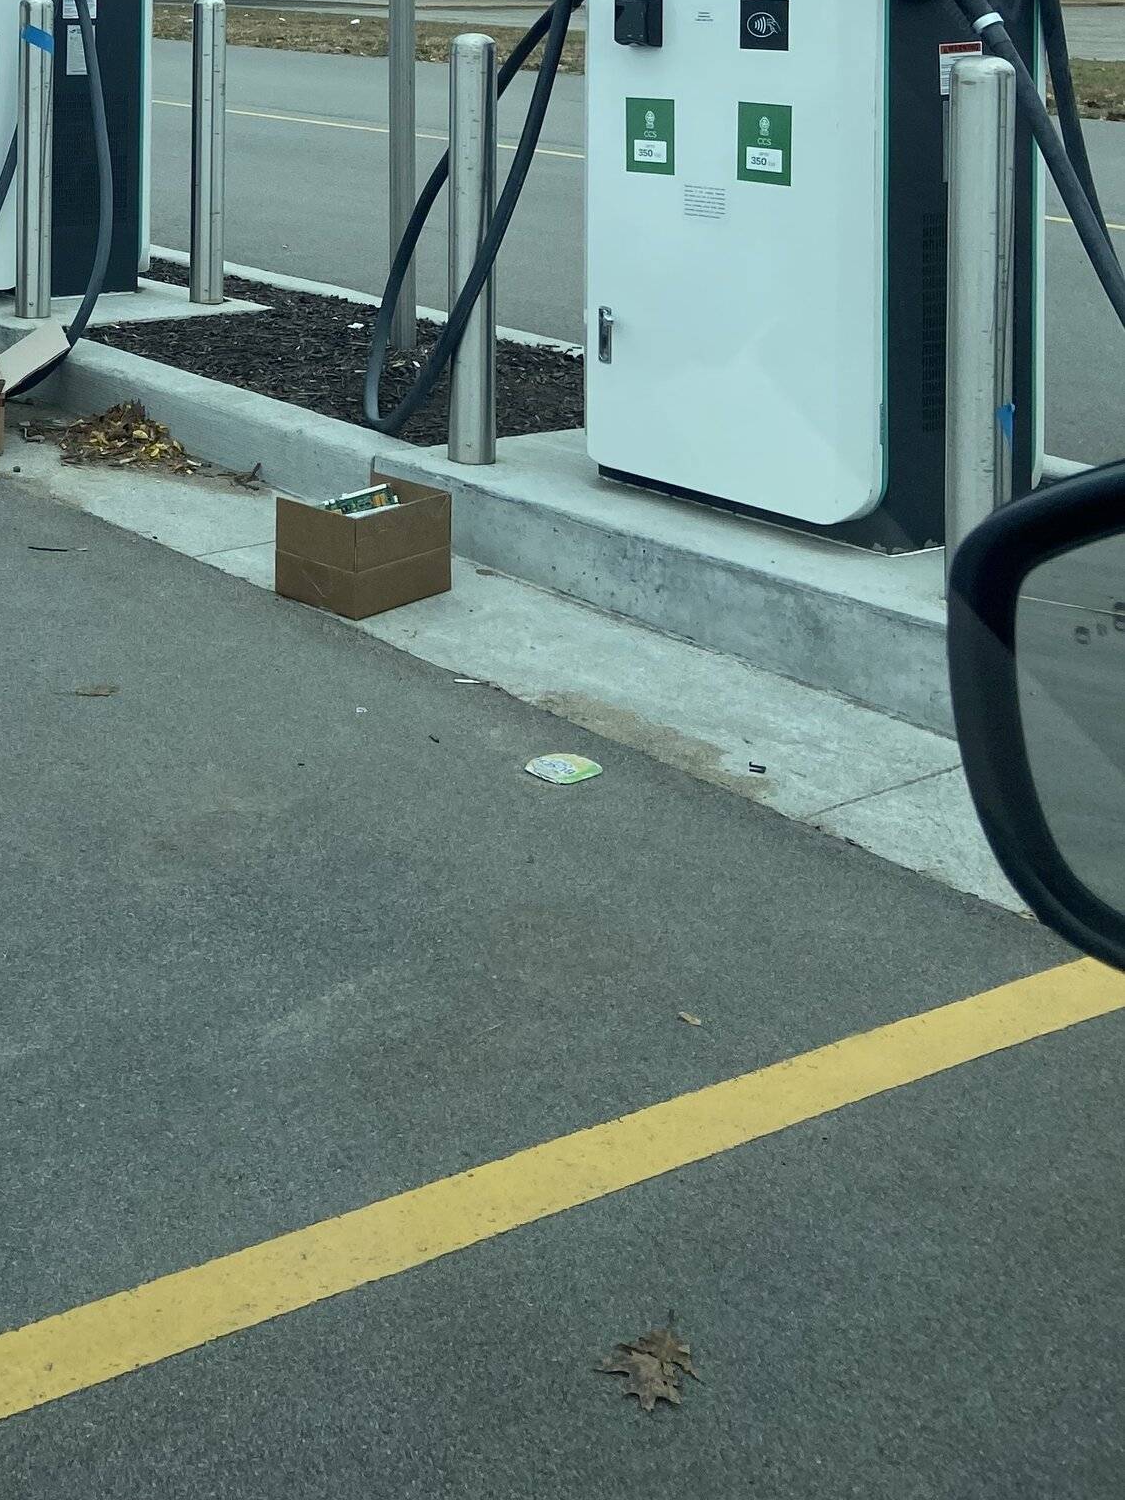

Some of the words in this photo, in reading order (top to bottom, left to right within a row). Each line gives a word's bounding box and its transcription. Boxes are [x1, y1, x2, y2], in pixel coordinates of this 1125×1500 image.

[644, 130, 658, 139] CCS
[757, 137, 772, 146] CCS
[638, 148, 653, 158] 350
[750, 156, 767, 166] 350
